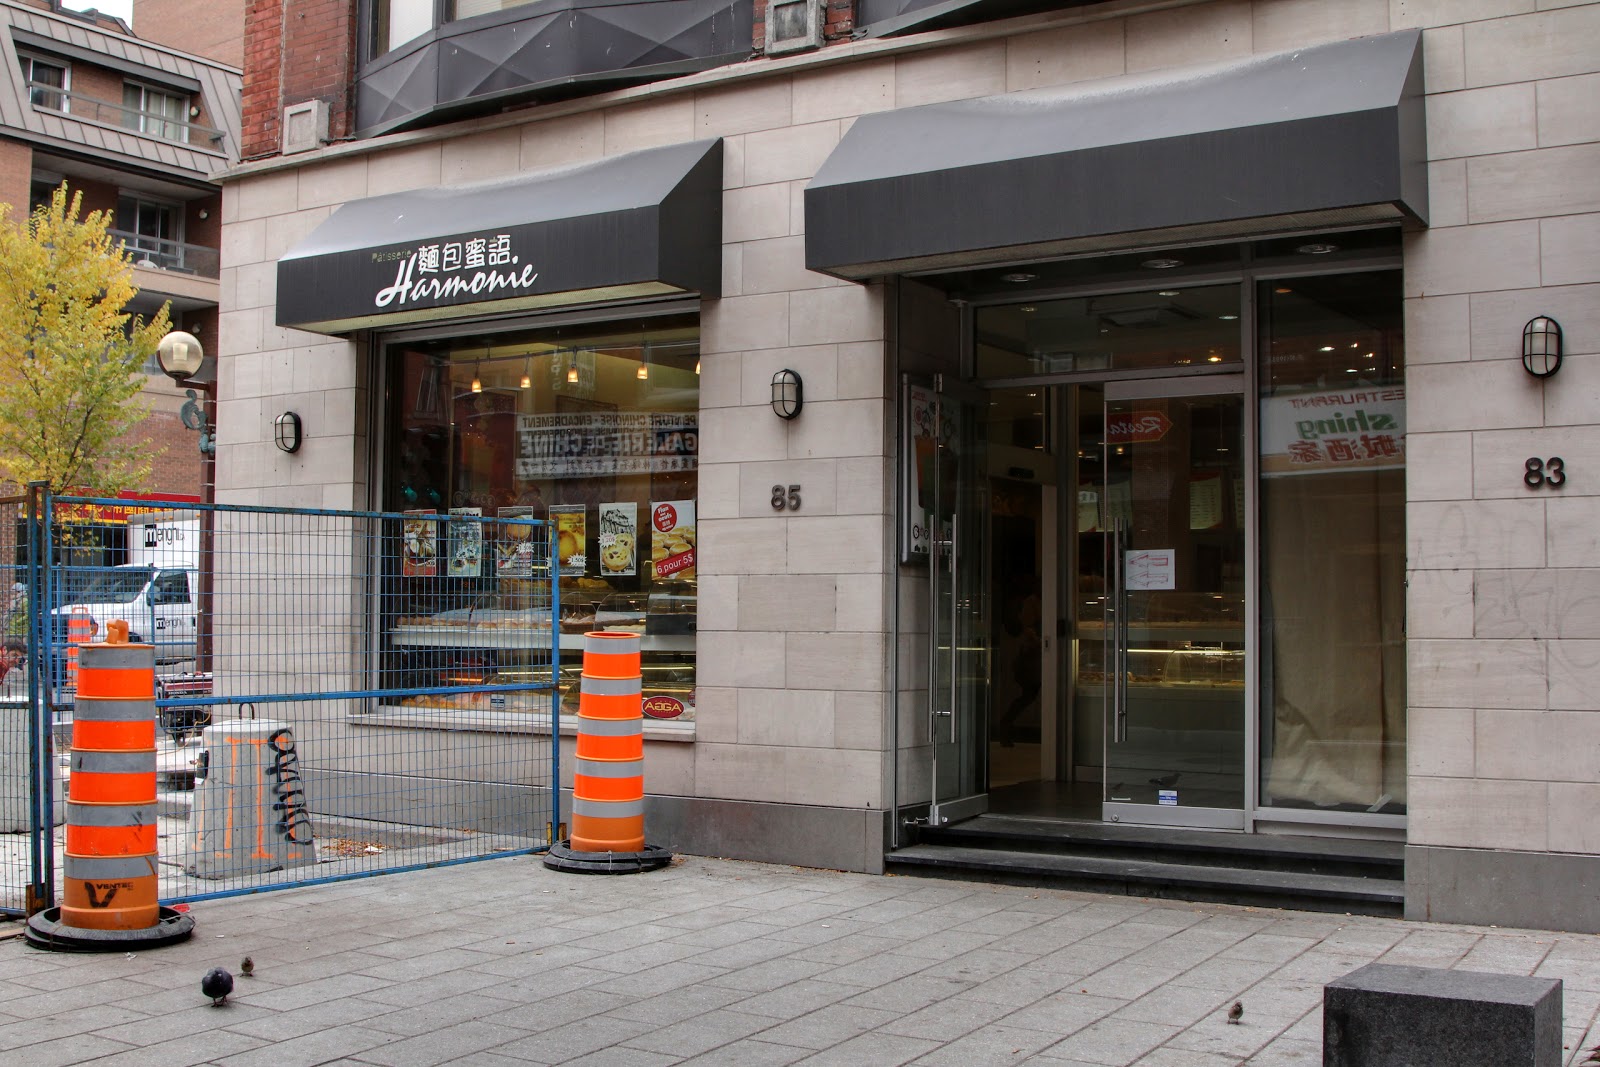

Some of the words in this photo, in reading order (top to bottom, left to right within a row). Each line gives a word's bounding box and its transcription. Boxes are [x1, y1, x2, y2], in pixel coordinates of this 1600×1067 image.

[417, 234, 511, 275] 麵包蜜語
[375, 252, 539, 308] Harmonie
[1524, 457, 1566, 488] 83
[771, 484, 801, 511] 85
[656, 565, 663, 574] 6
[663, 559, 682, 573] pour
[682, 553, 694, 565] 5$
